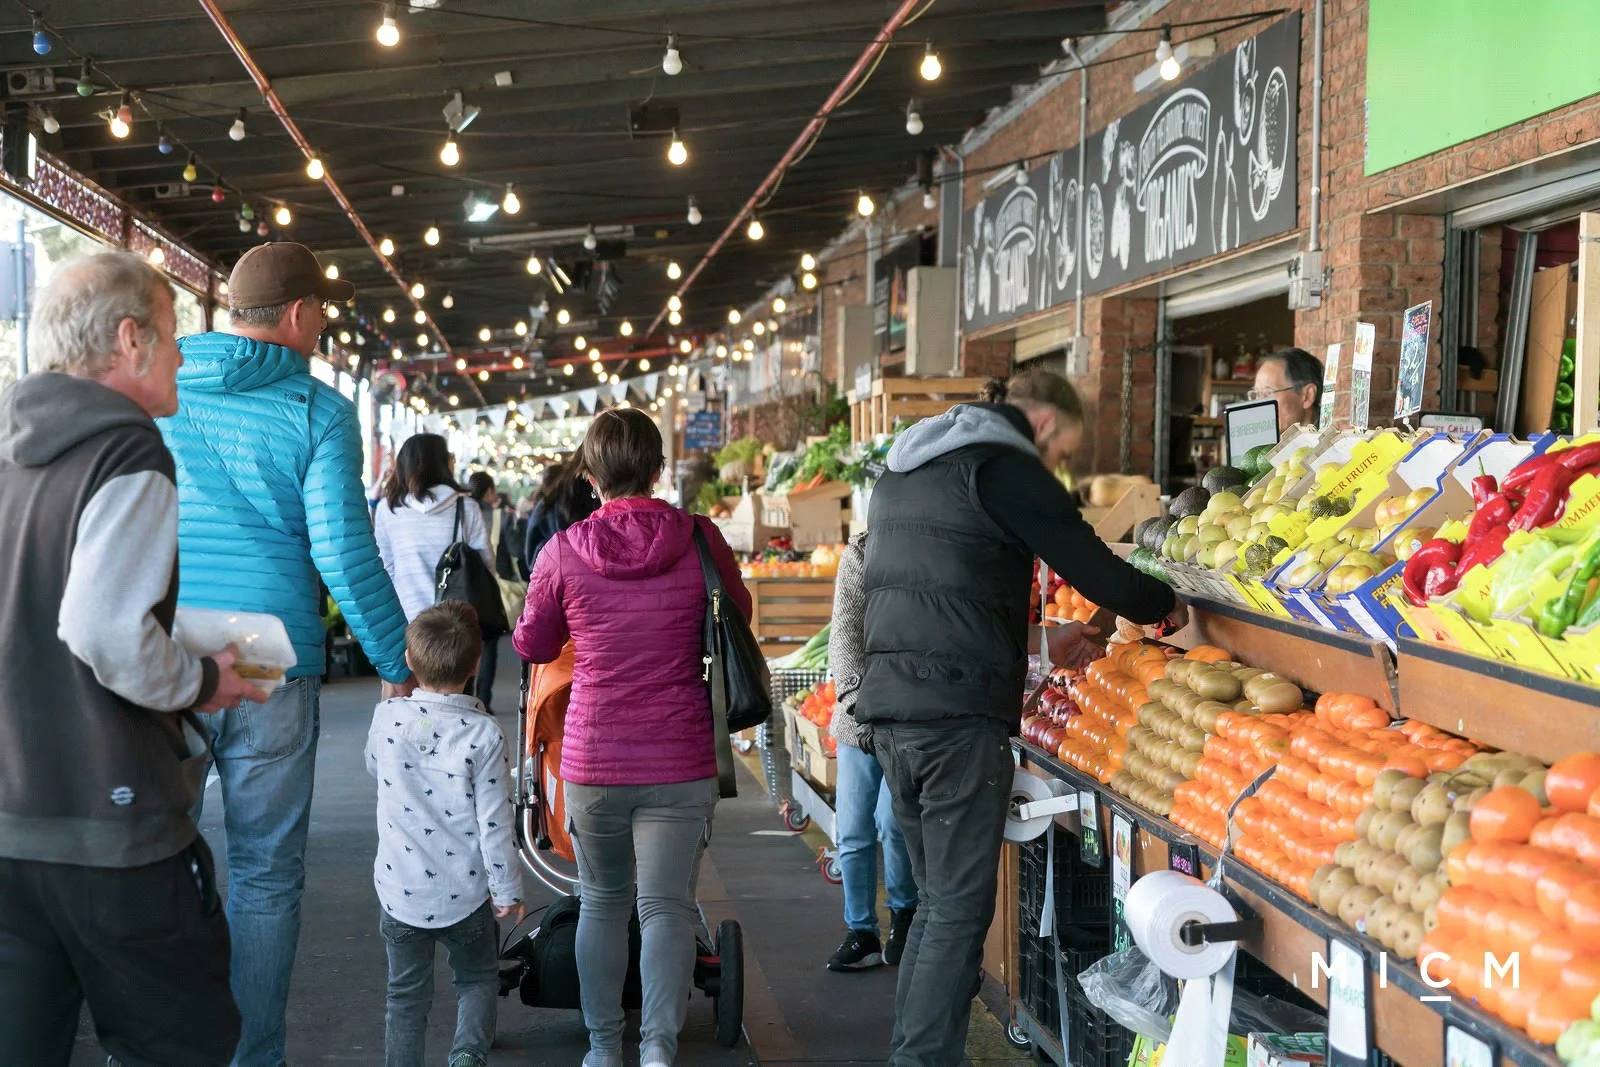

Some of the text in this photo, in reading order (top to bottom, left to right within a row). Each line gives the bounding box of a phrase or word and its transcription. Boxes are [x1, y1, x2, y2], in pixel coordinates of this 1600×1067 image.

[1145, 159, 1198, 263] ORGANICS
[1347, 452, 1378, 483] FRUITS
[1558, 490, 1600, 529] UMME
